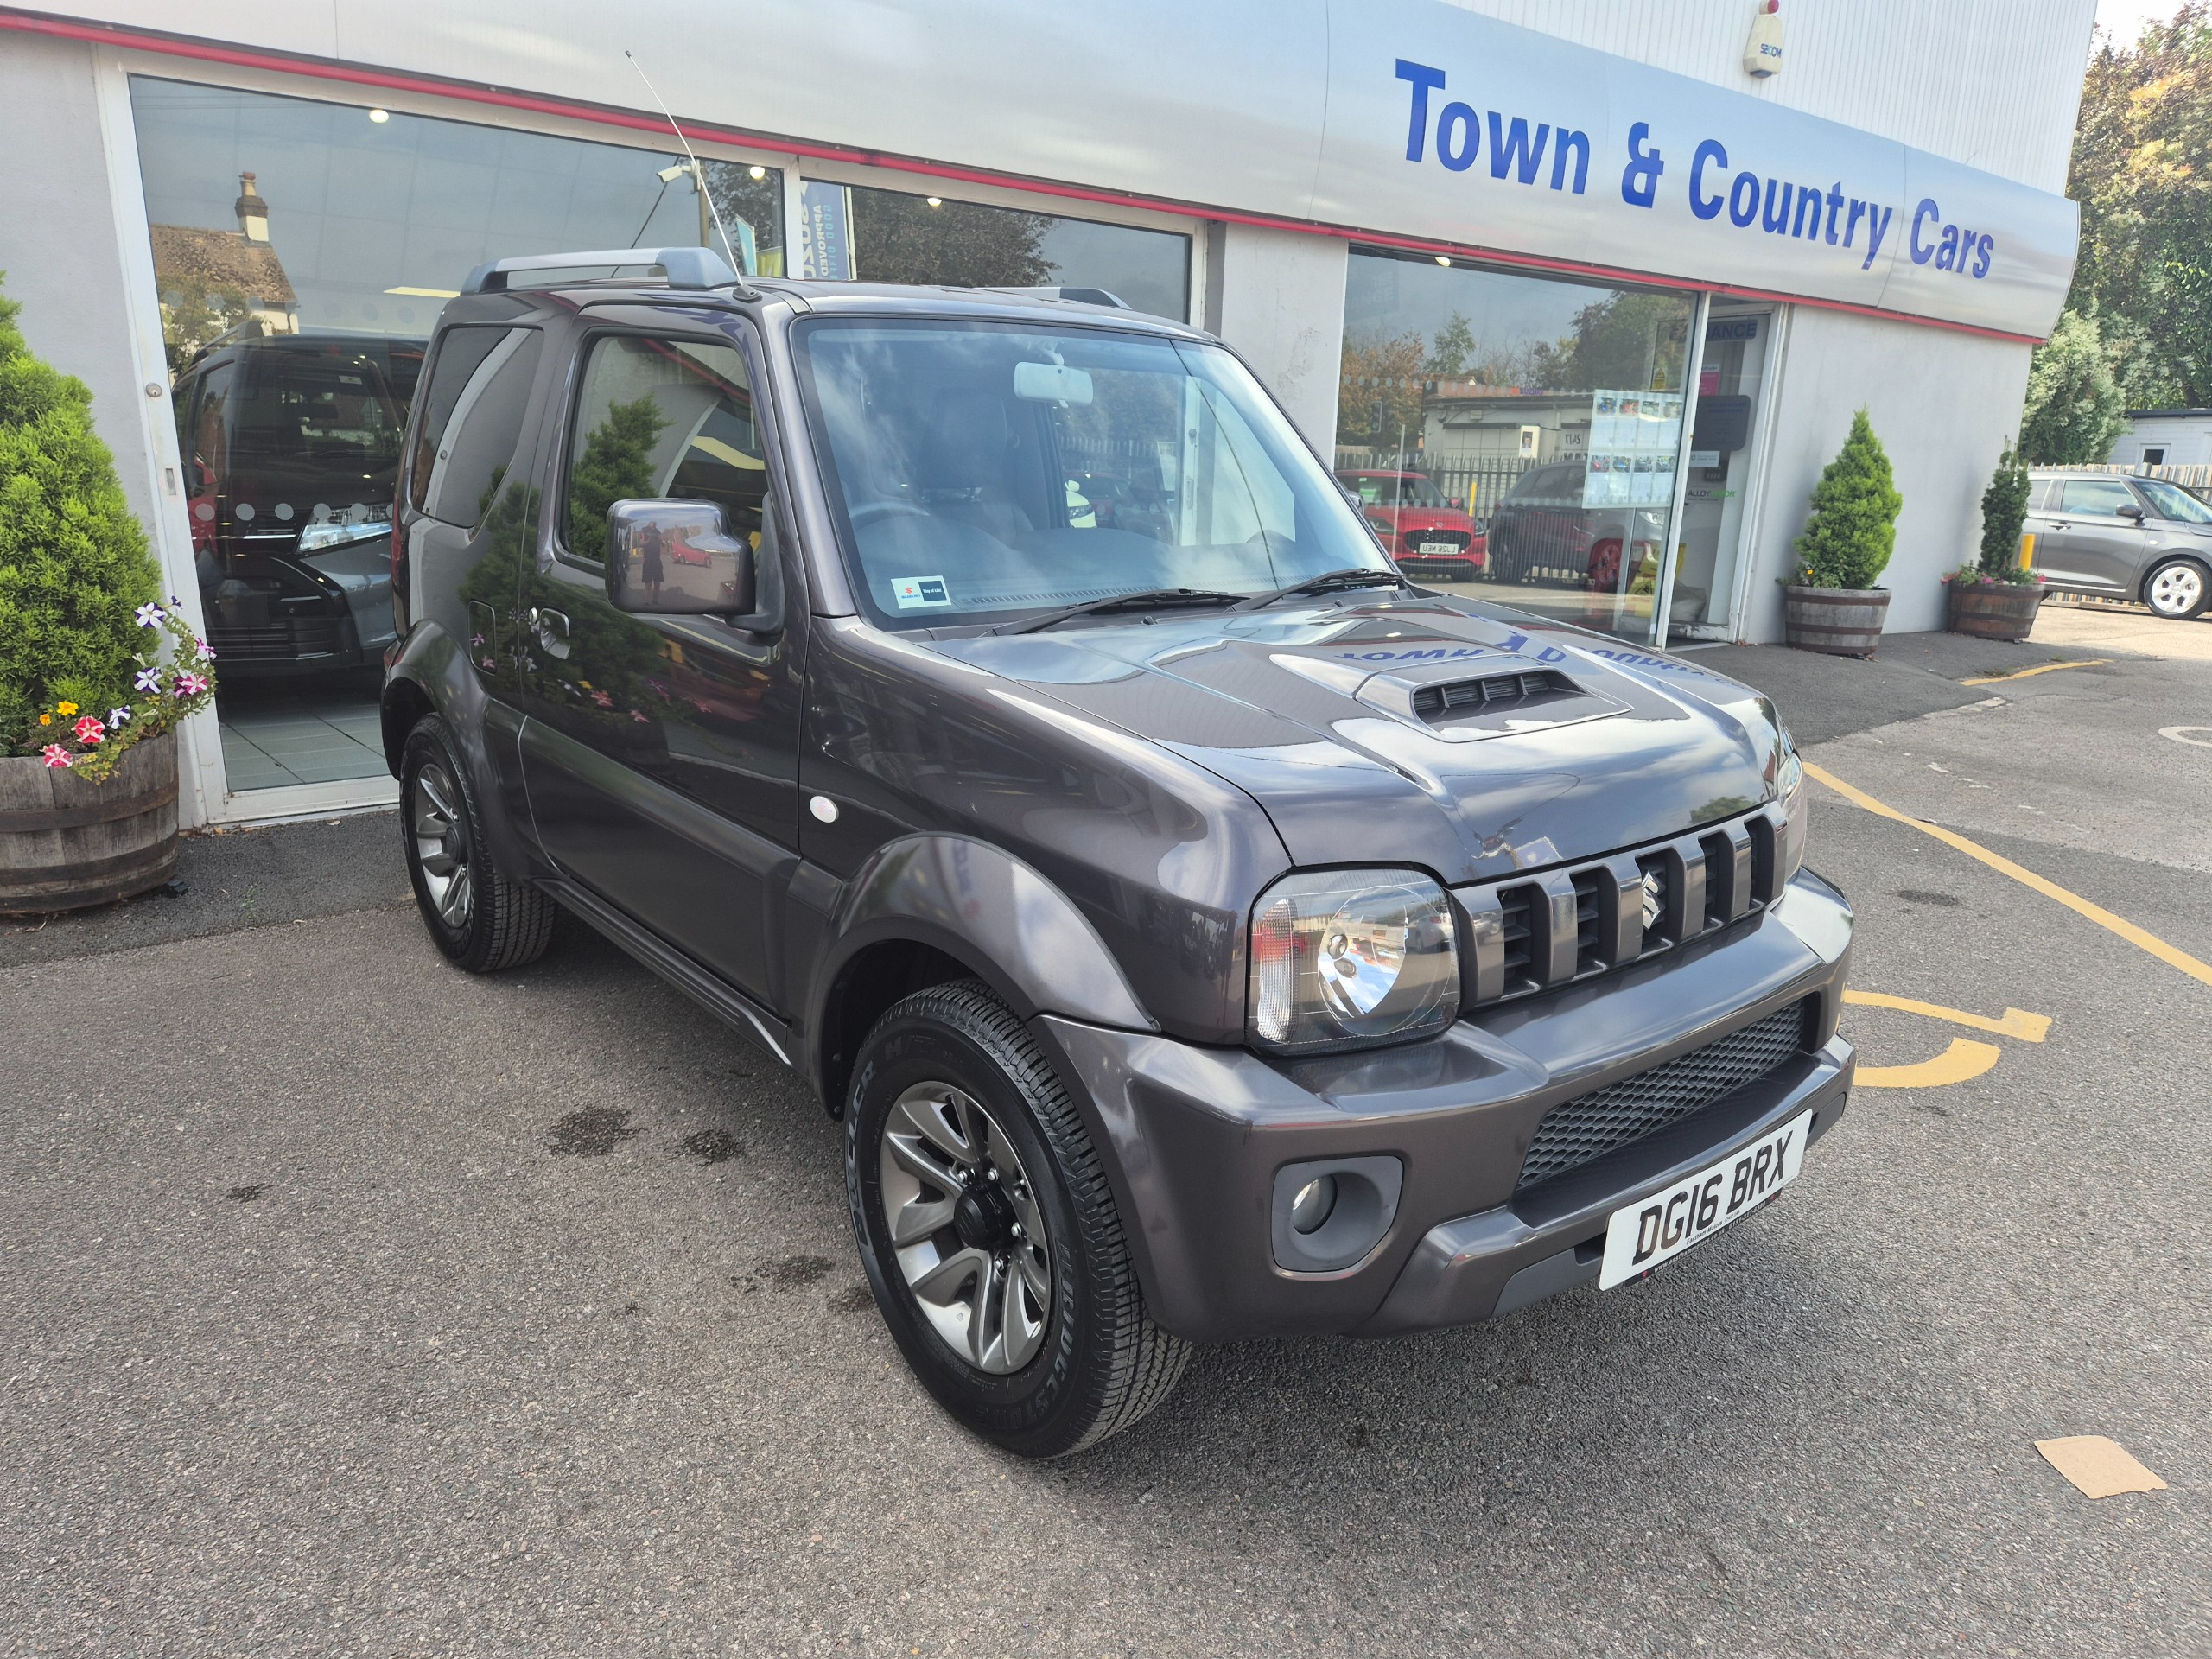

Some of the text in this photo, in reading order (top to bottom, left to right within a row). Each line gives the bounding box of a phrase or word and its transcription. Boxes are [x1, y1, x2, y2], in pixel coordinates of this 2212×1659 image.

[1395, 59, 1994, 279] Town & Country Cars
[1632, 1129, 1794, 1266] DG16 BRX
